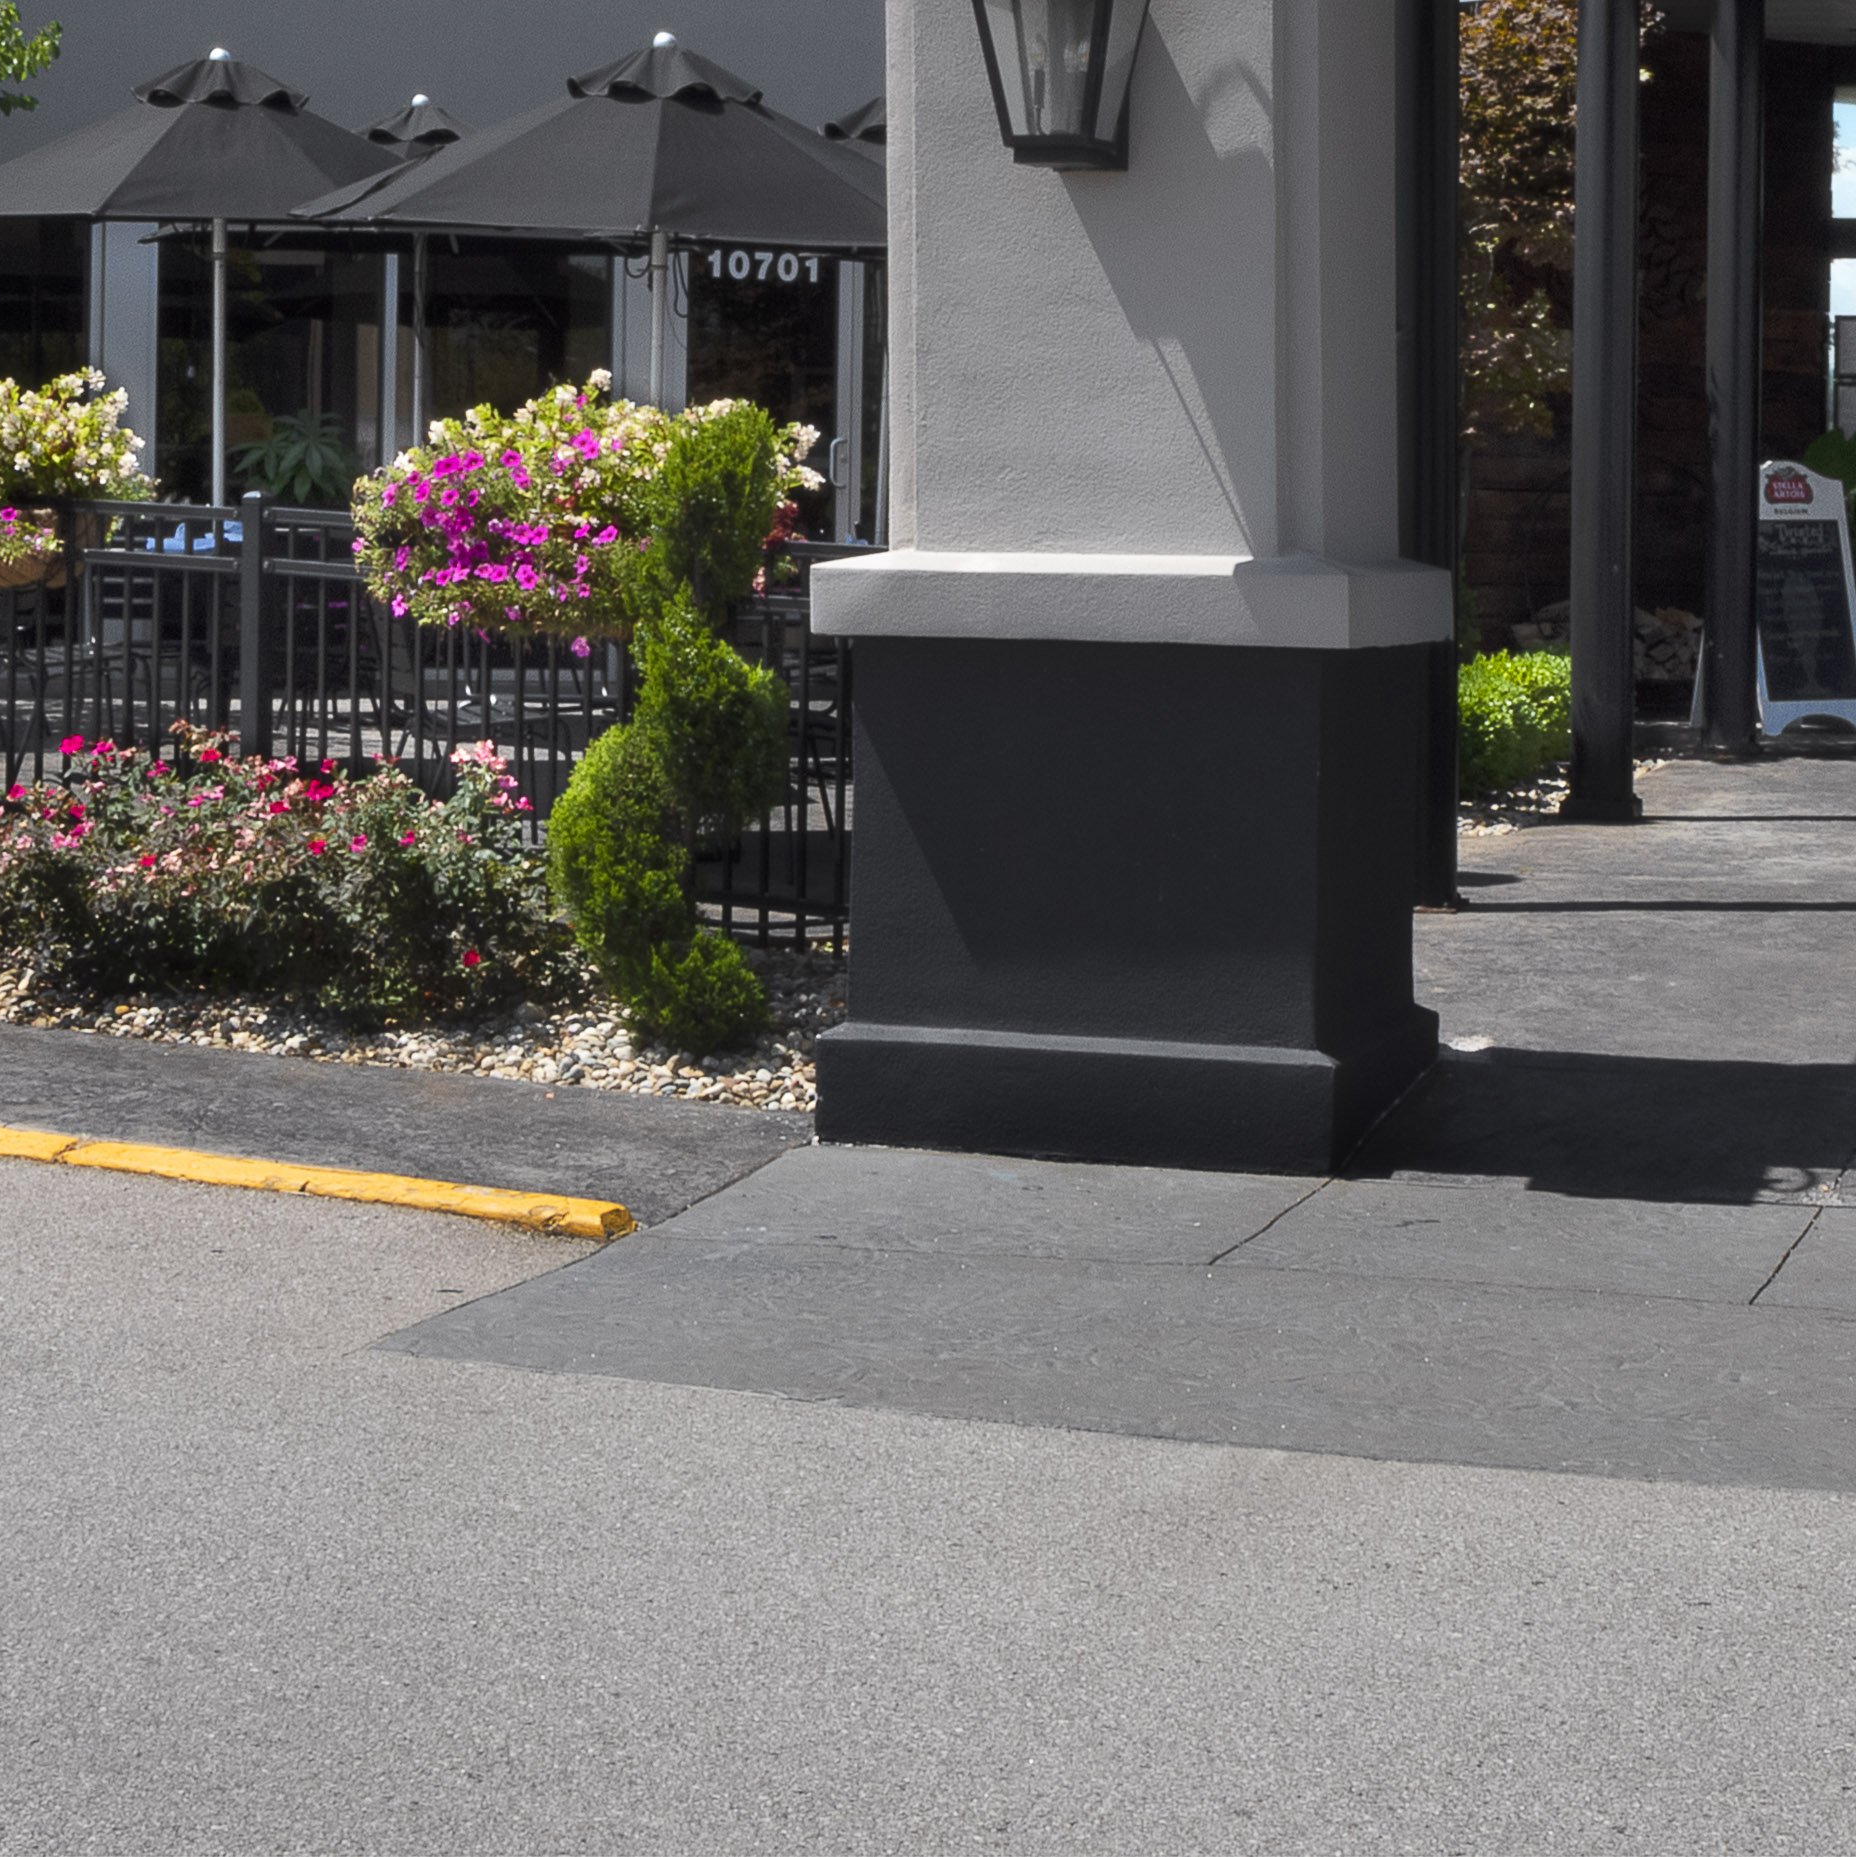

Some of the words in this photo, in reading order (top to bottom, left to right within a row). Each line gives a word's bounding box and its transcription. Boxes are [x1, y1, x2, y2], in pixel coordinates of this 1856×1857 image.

[708, 250, 819, 283] 10701
[1772, 481, 1804, 489] STELLA
[1774, 490, 1805, 498] ARTOIS
